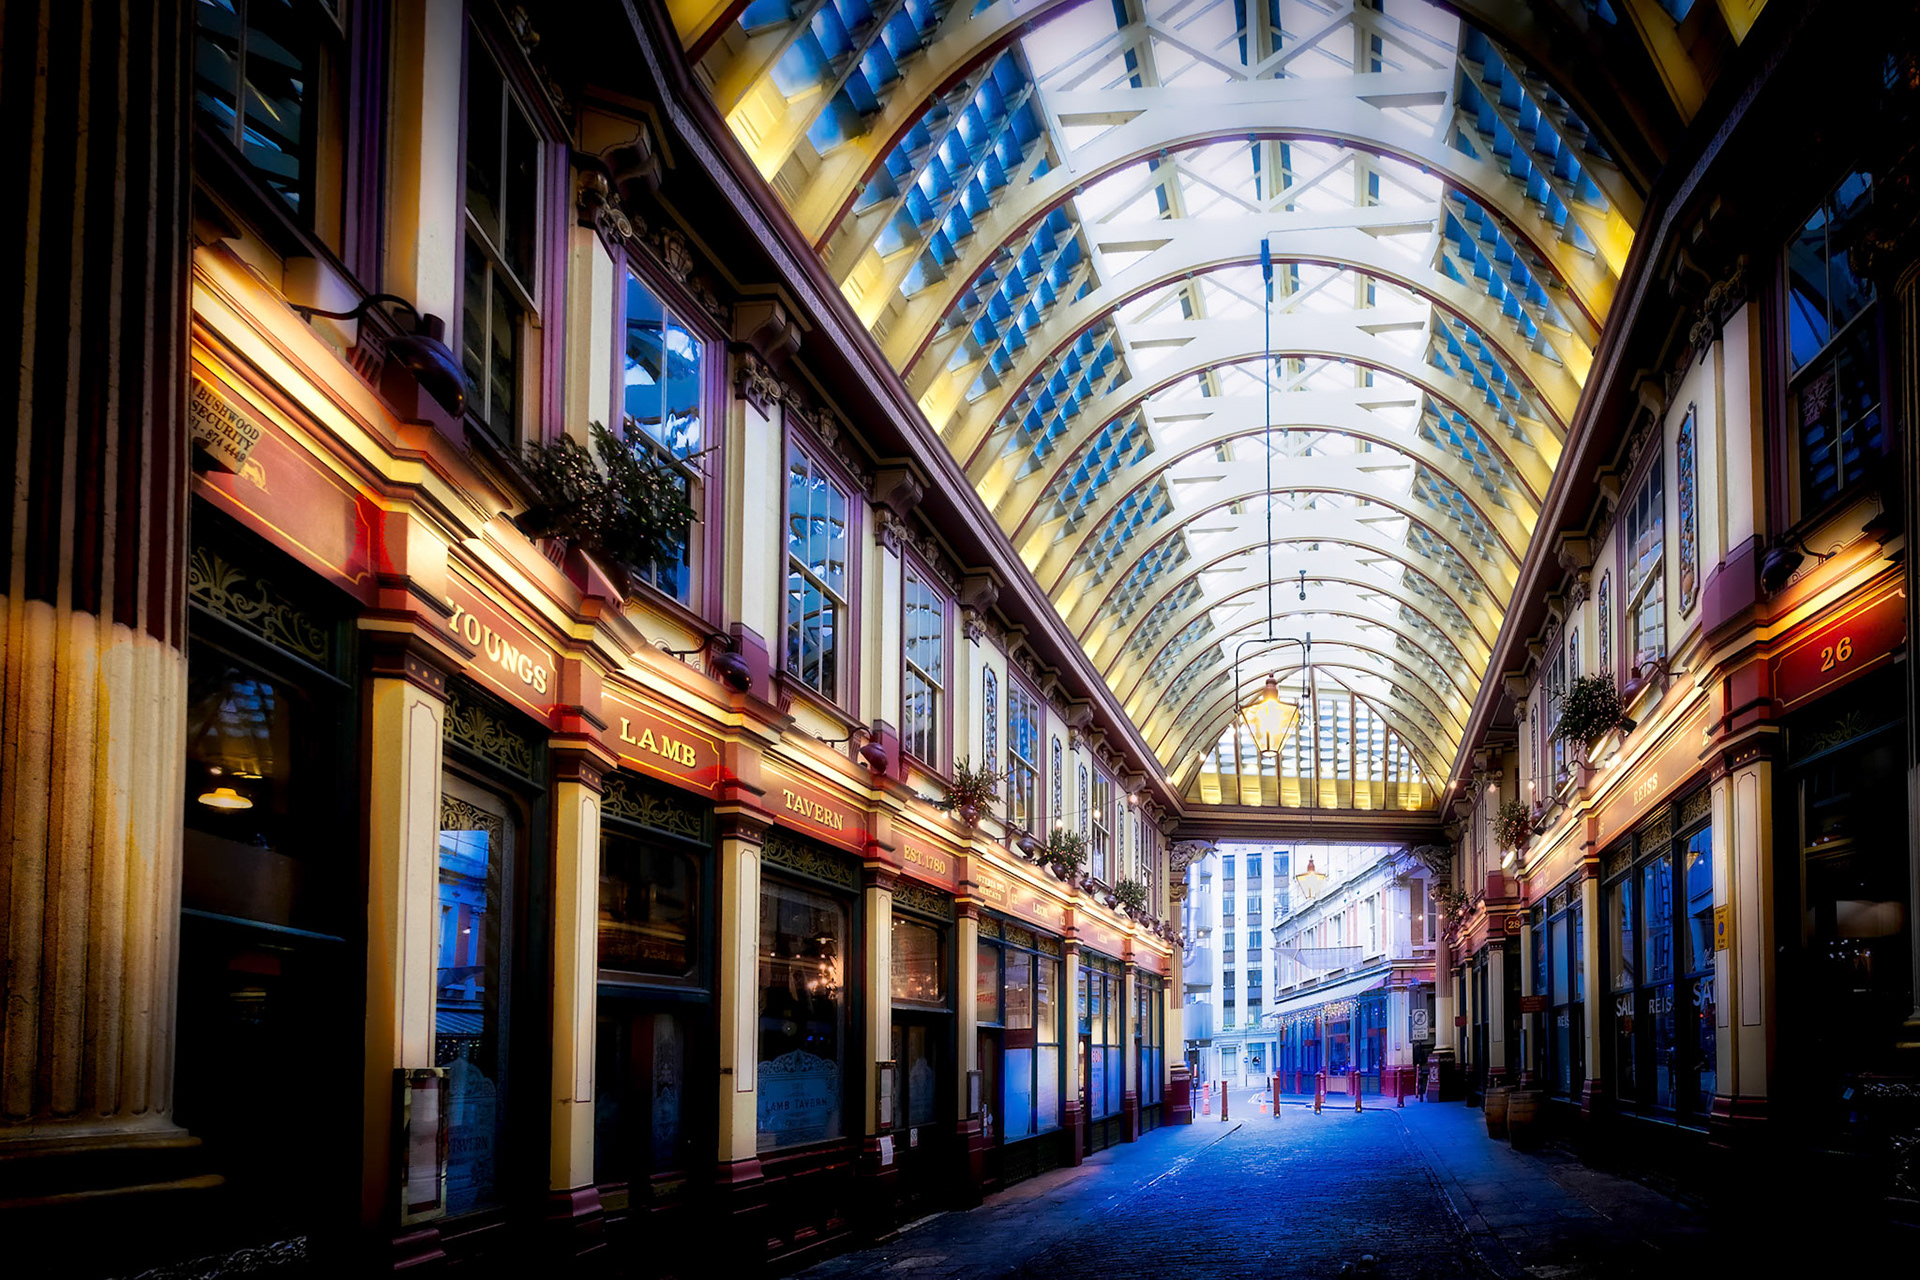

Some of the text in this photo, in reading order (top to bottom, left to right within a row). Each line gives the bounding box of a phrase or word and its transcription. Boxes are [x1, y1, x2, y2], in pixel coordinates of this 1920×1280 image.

[191, 399, 254, 451] SECURITY
[196, 386, 260, 440] BUSHWOOD
[223, 443, 247, 463] 4449
[447, 598, 548, 695] YOUNGS
[1820, 636, 1853, 673] 26
[619, 716, 697, 769] LAMB
[1633, 772, 1659, 807] REISS
[783, 788, 844, 831] TAVERN
[1508, 920, 1521, 929] 28
[1616, 996, 1635, 1017] SAL
[1648, 996, 1675, 1015] REIS
[765, 1096, 829, 1115] LAMB TAVERN
